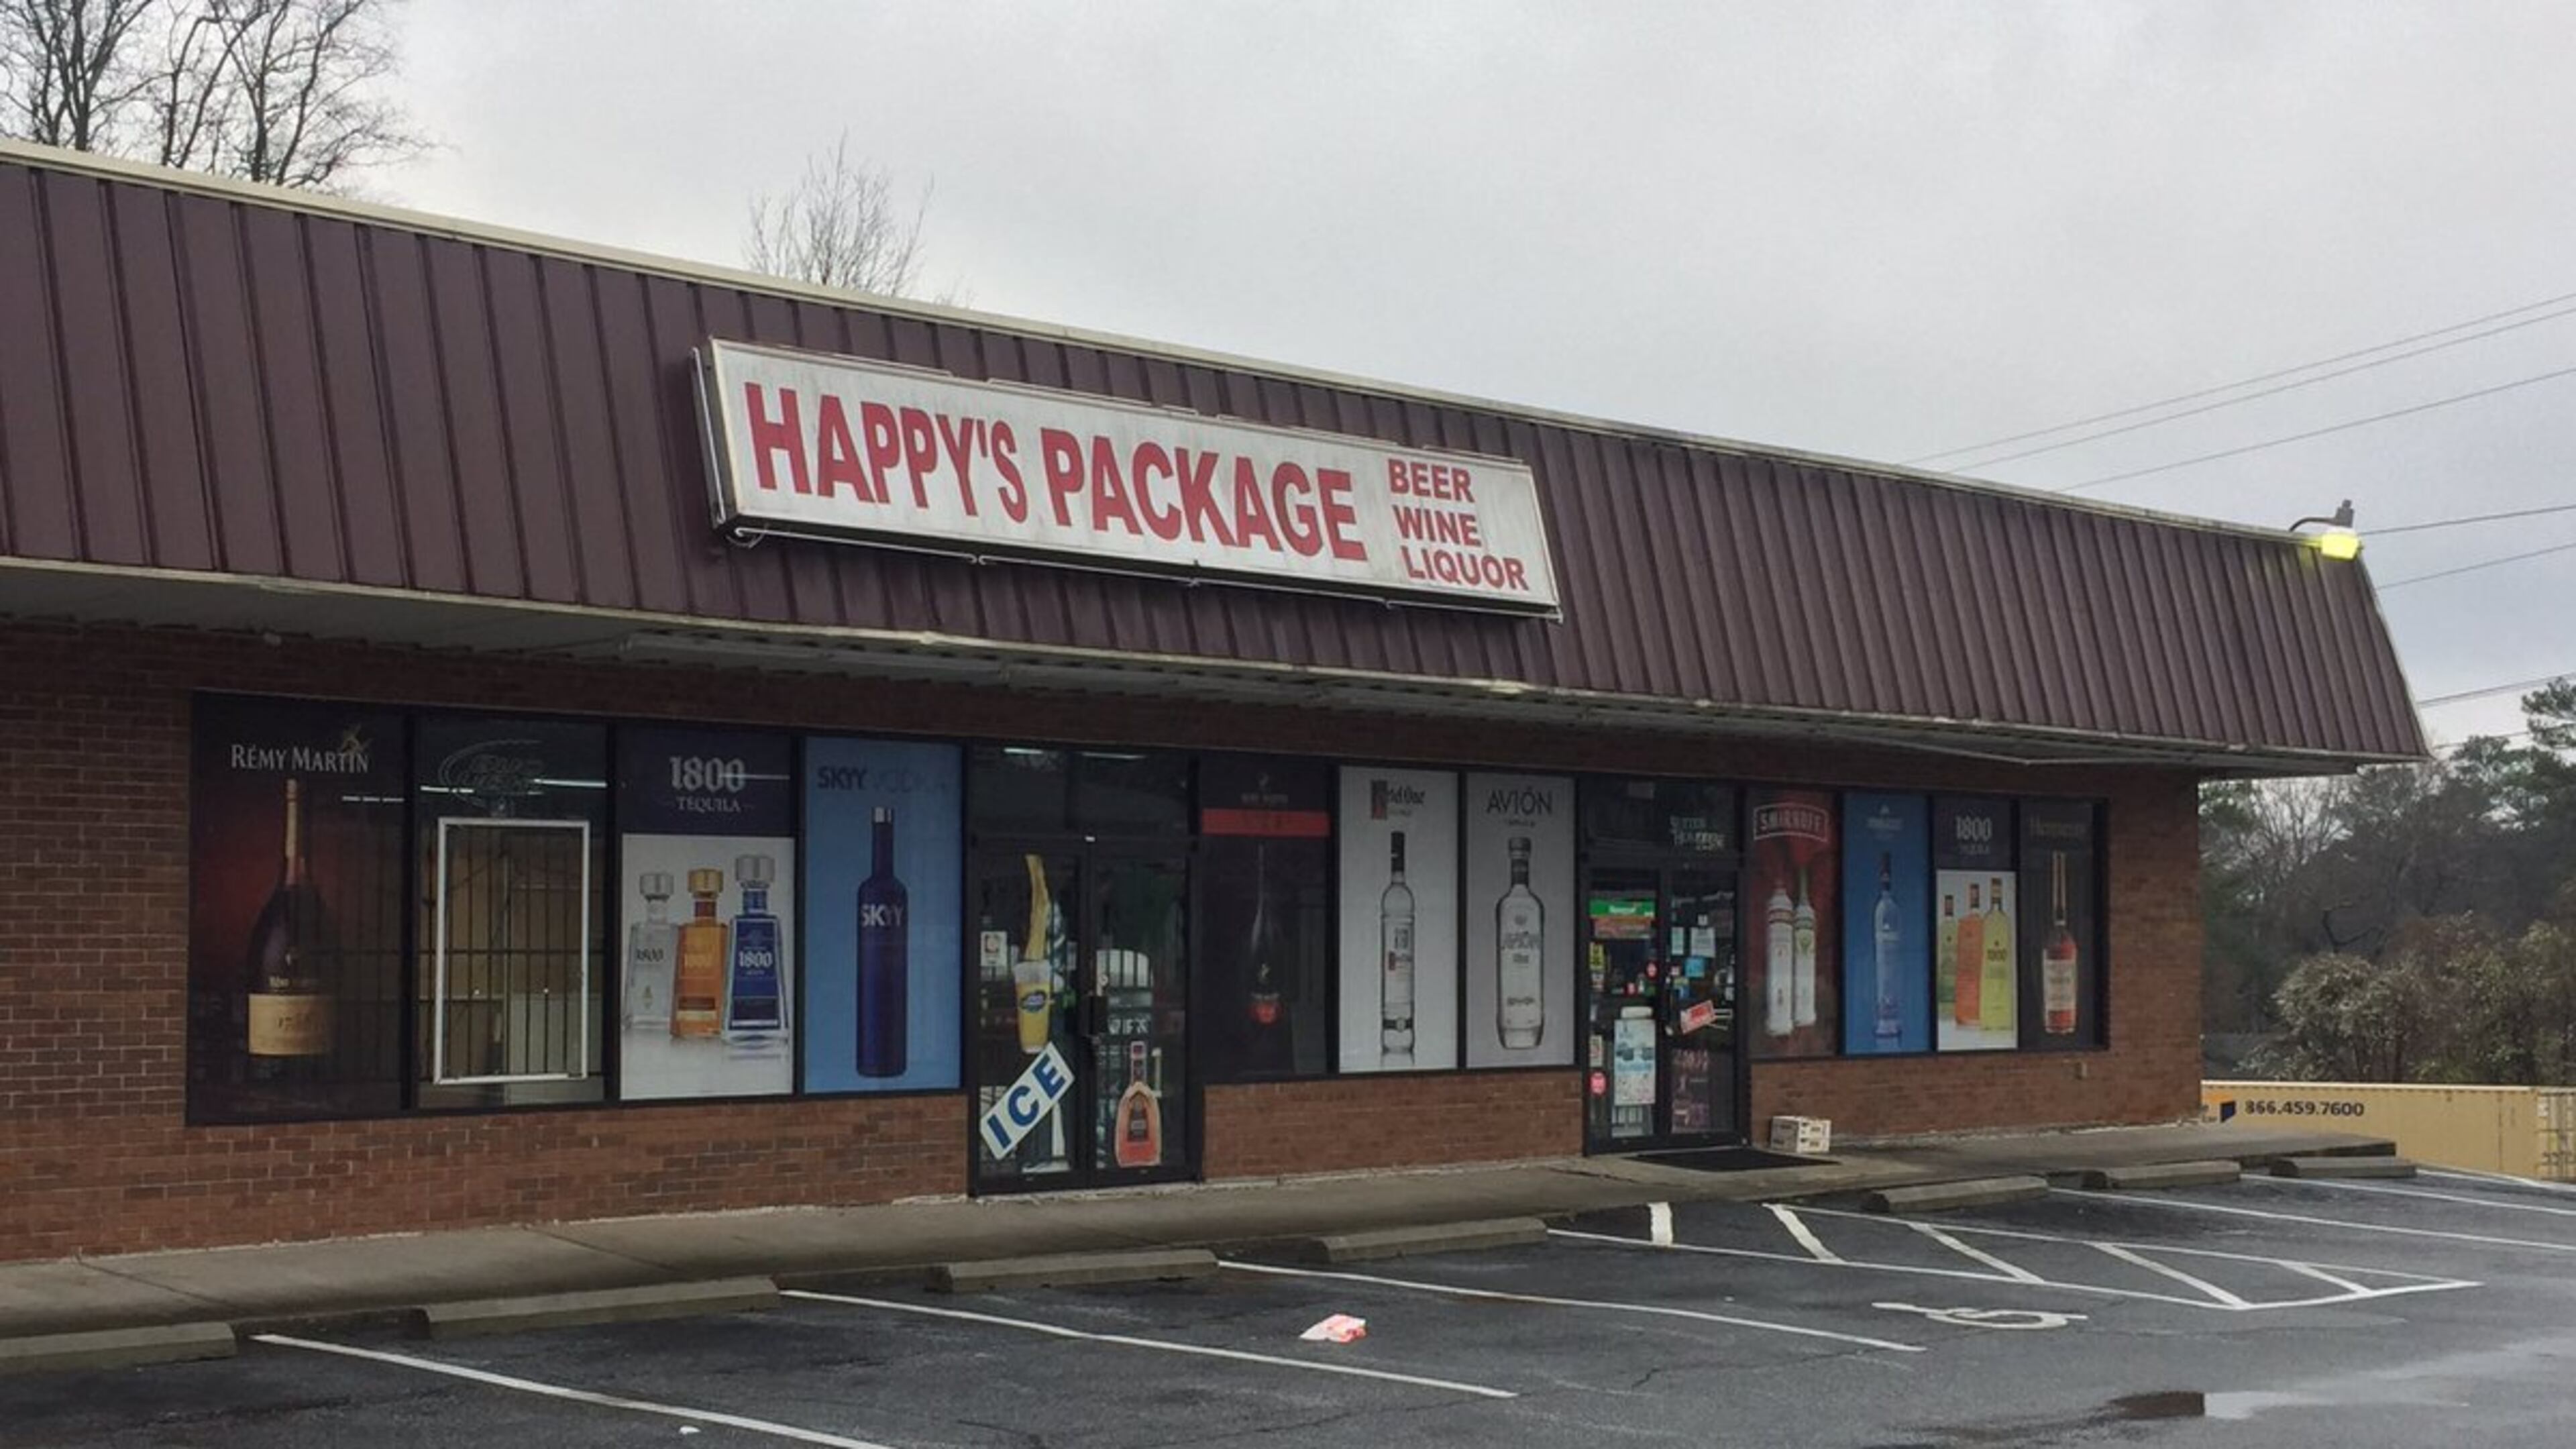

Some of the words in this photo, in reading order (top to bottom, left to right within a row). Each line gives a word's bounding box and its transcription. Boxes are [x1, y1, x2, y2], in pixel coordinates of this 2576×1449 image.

[745, 382, 1028, 523] HAPPY'S
[1040, 427, 1368, 561] PACKAGE
[1387, 458, 1475, 504] BEER
[1392, 504, 1483, 547] WINE
[1400, 546, 1529, 592] LIQUOR
[669, 755, 746, 793] 1800
[676, 796, 741, 813] TEQUILA
[1486, 786, 1553, 816] AVIÓN
[1955, 815, 1992, 841] 1800
[739, 951, 772, 967] 1800
[986, 1053, 1067, 1149] ICE
[2244, 1100, 2365, 1117] 866.459.7600
